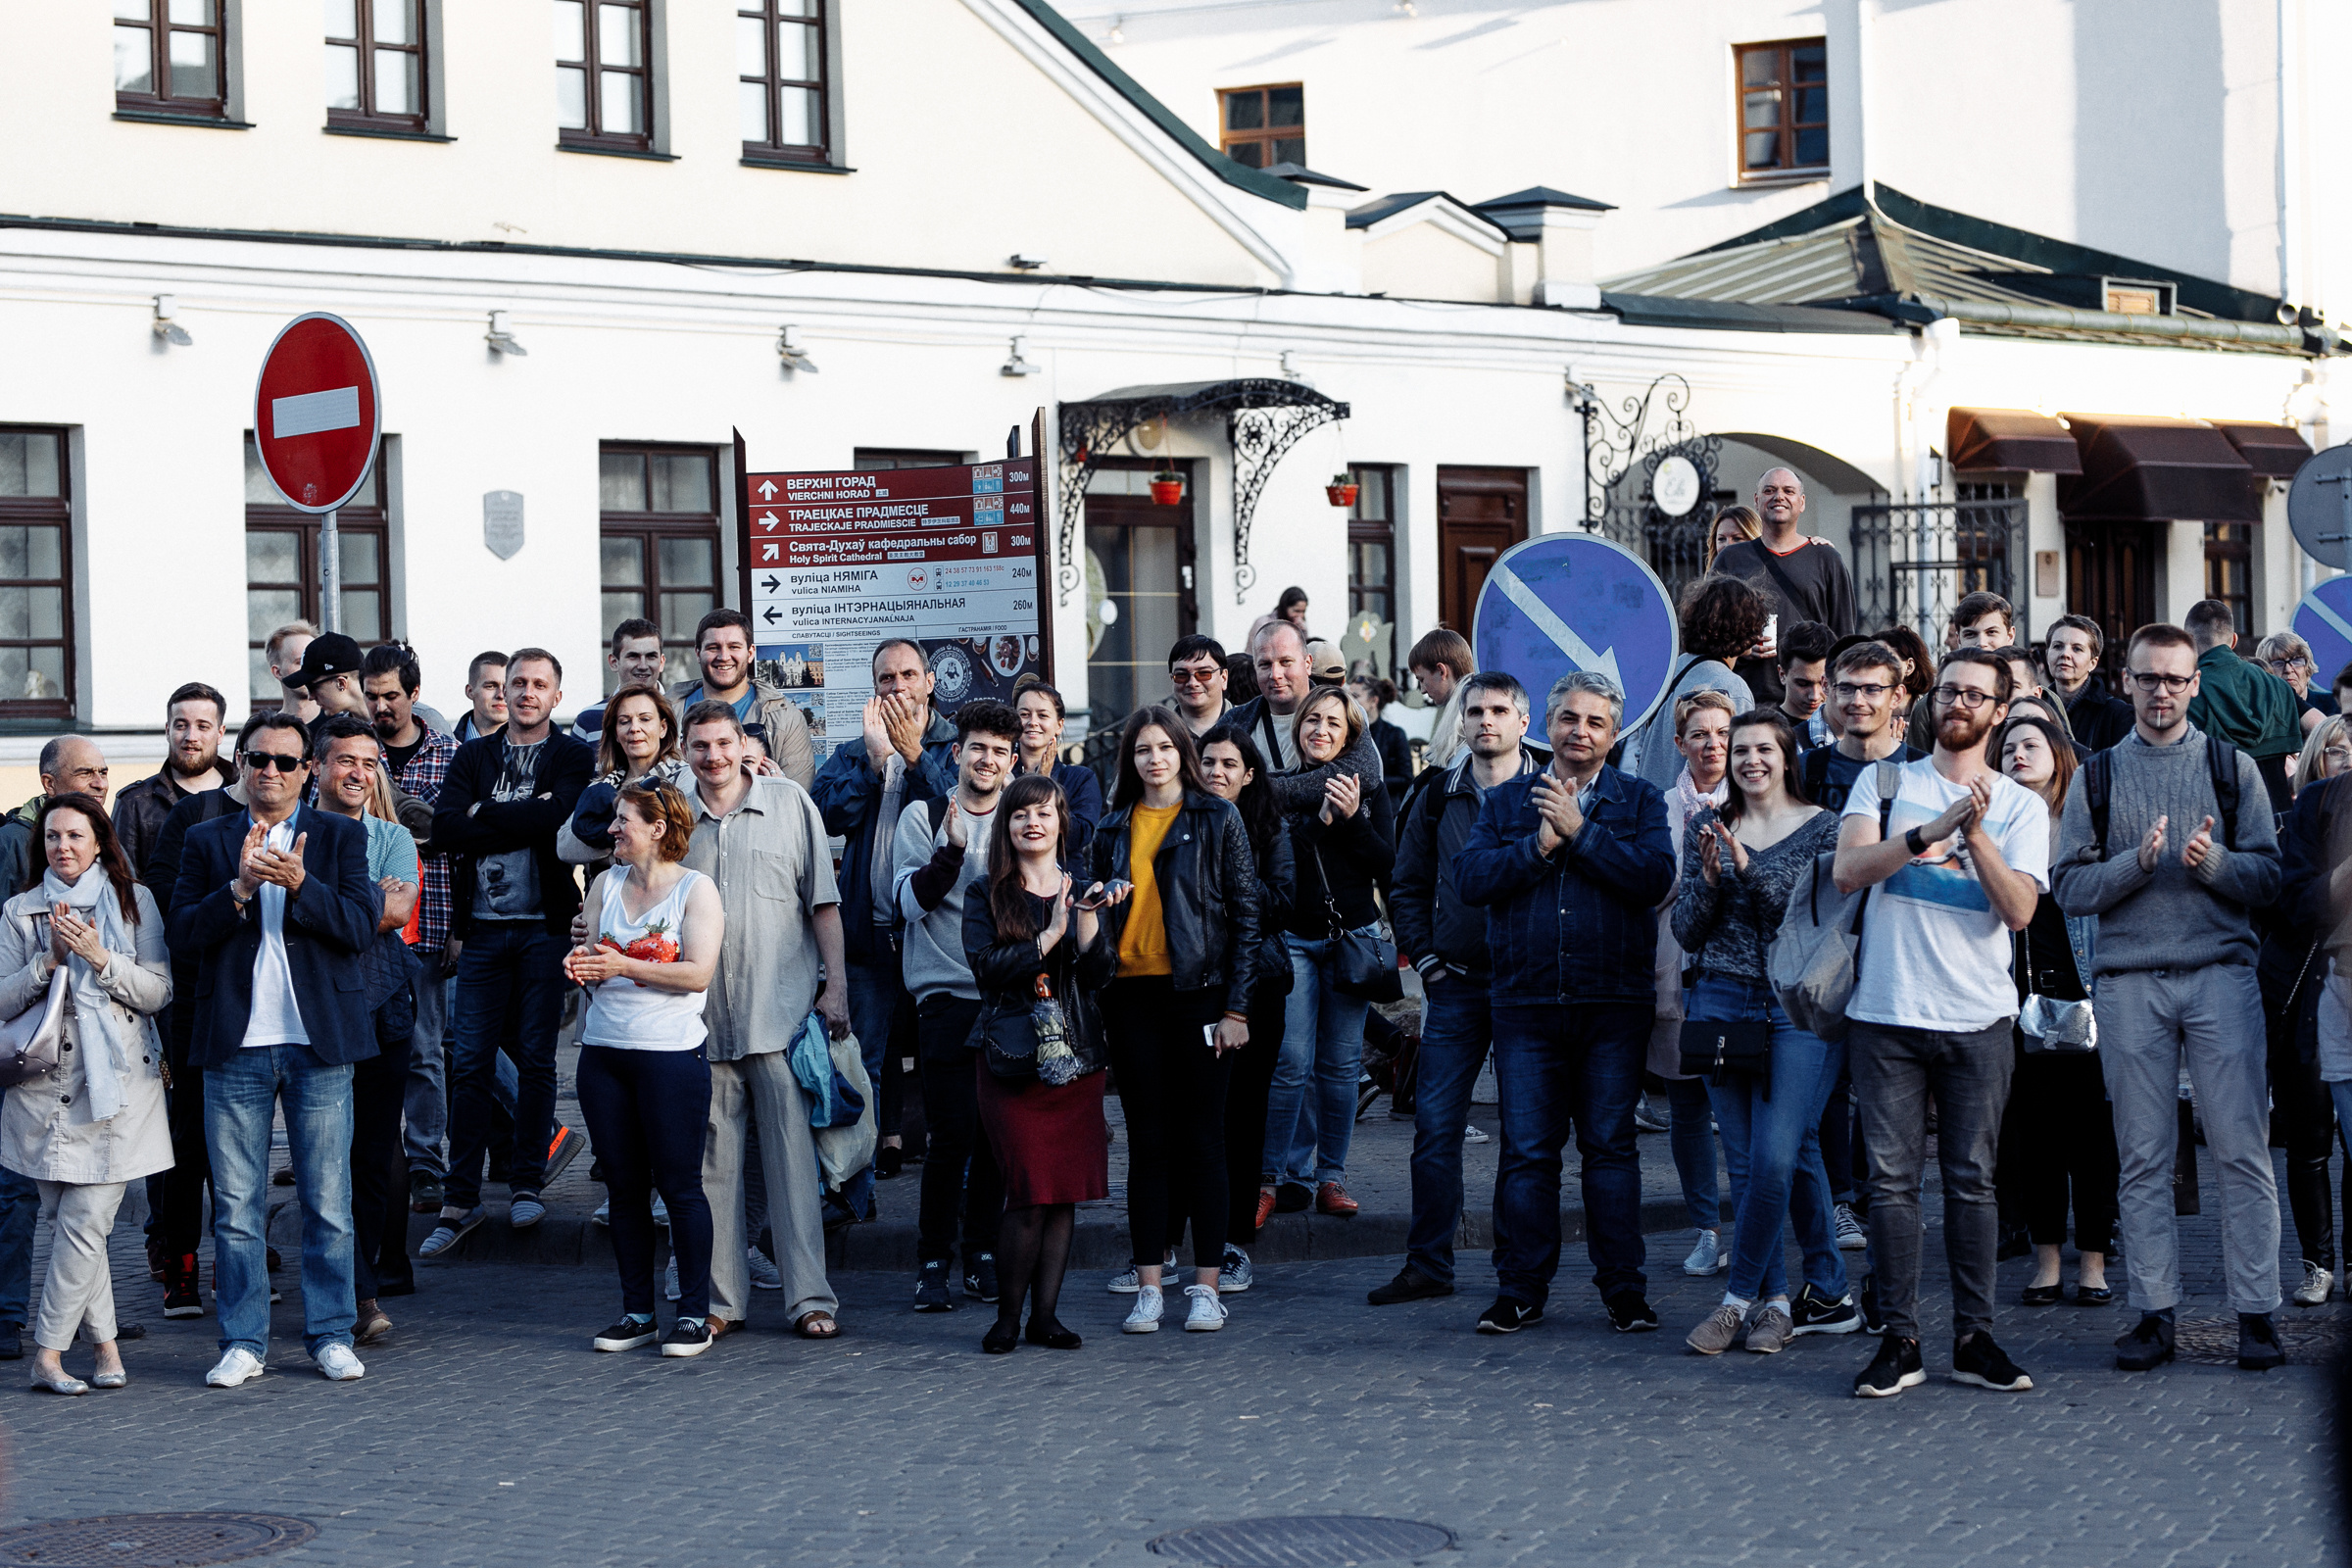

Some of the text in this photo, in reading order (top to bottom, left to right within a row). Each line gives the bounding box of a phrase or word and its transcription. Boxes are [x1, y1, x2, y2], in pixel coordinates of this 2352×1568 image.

[1009, 471, 1029, 482] 300м
[787, 476, 876, 490] ВЕРХНІ ГОРАД
[788, 490, 870, 501] VIERCHNI HORAD
[788, 504, 929, 521] ТРАЕЦКАЕ ПРАДМЕСЦЕ
[1010, 503, 1030, 514] 440м
[789, 518, 916, 532] TRAJECKAJE PRADMIESCIE
[789, 534, 977, 552] Свята-Духаў кафедральны сабор
[1011, 535, 1031, 546] 300м
[789, 552, 882, 565] Holy Spirit Cathedral
[791, 570, 878, 586] вуліца НЯМІГА
[1012, 567, 1032, 578] 240м
[821, 585, 861, 593] NIAMIHA
[792, 598, 965, 617] вуліца ІНТЭРНАЦЫЯНАЛЬНАЯ
[1013, 600, 1033, 611] 260м
